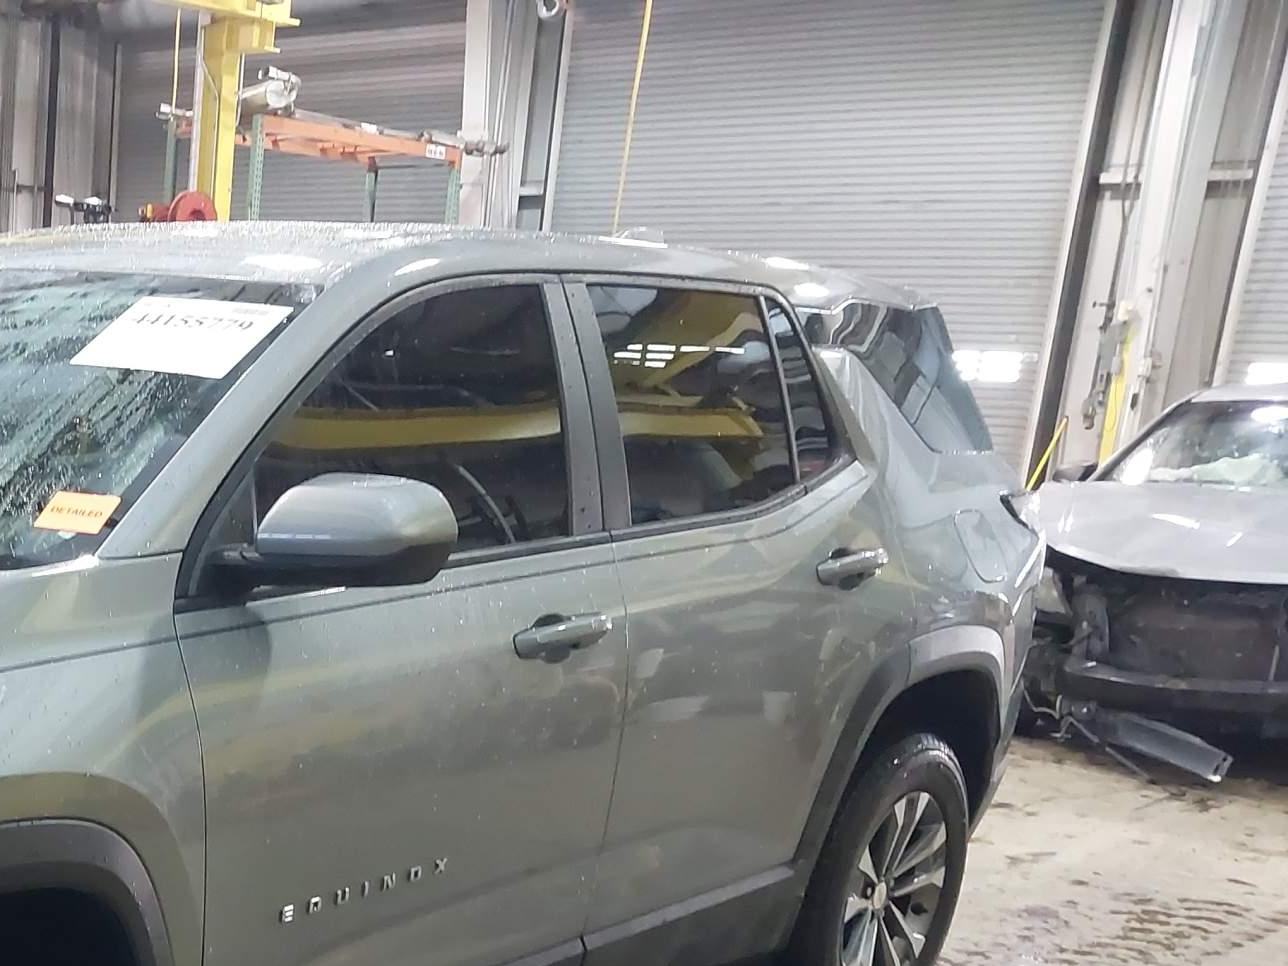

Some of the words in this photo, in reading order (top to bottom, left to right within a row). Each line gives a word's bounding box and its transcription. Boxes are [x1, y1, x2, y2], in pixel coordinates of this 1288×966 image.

[132, 312, 254, 330] 44155779
[49, 505, 104, 519] DETAILED
[280, 857, 448, 923] EQUINOX
